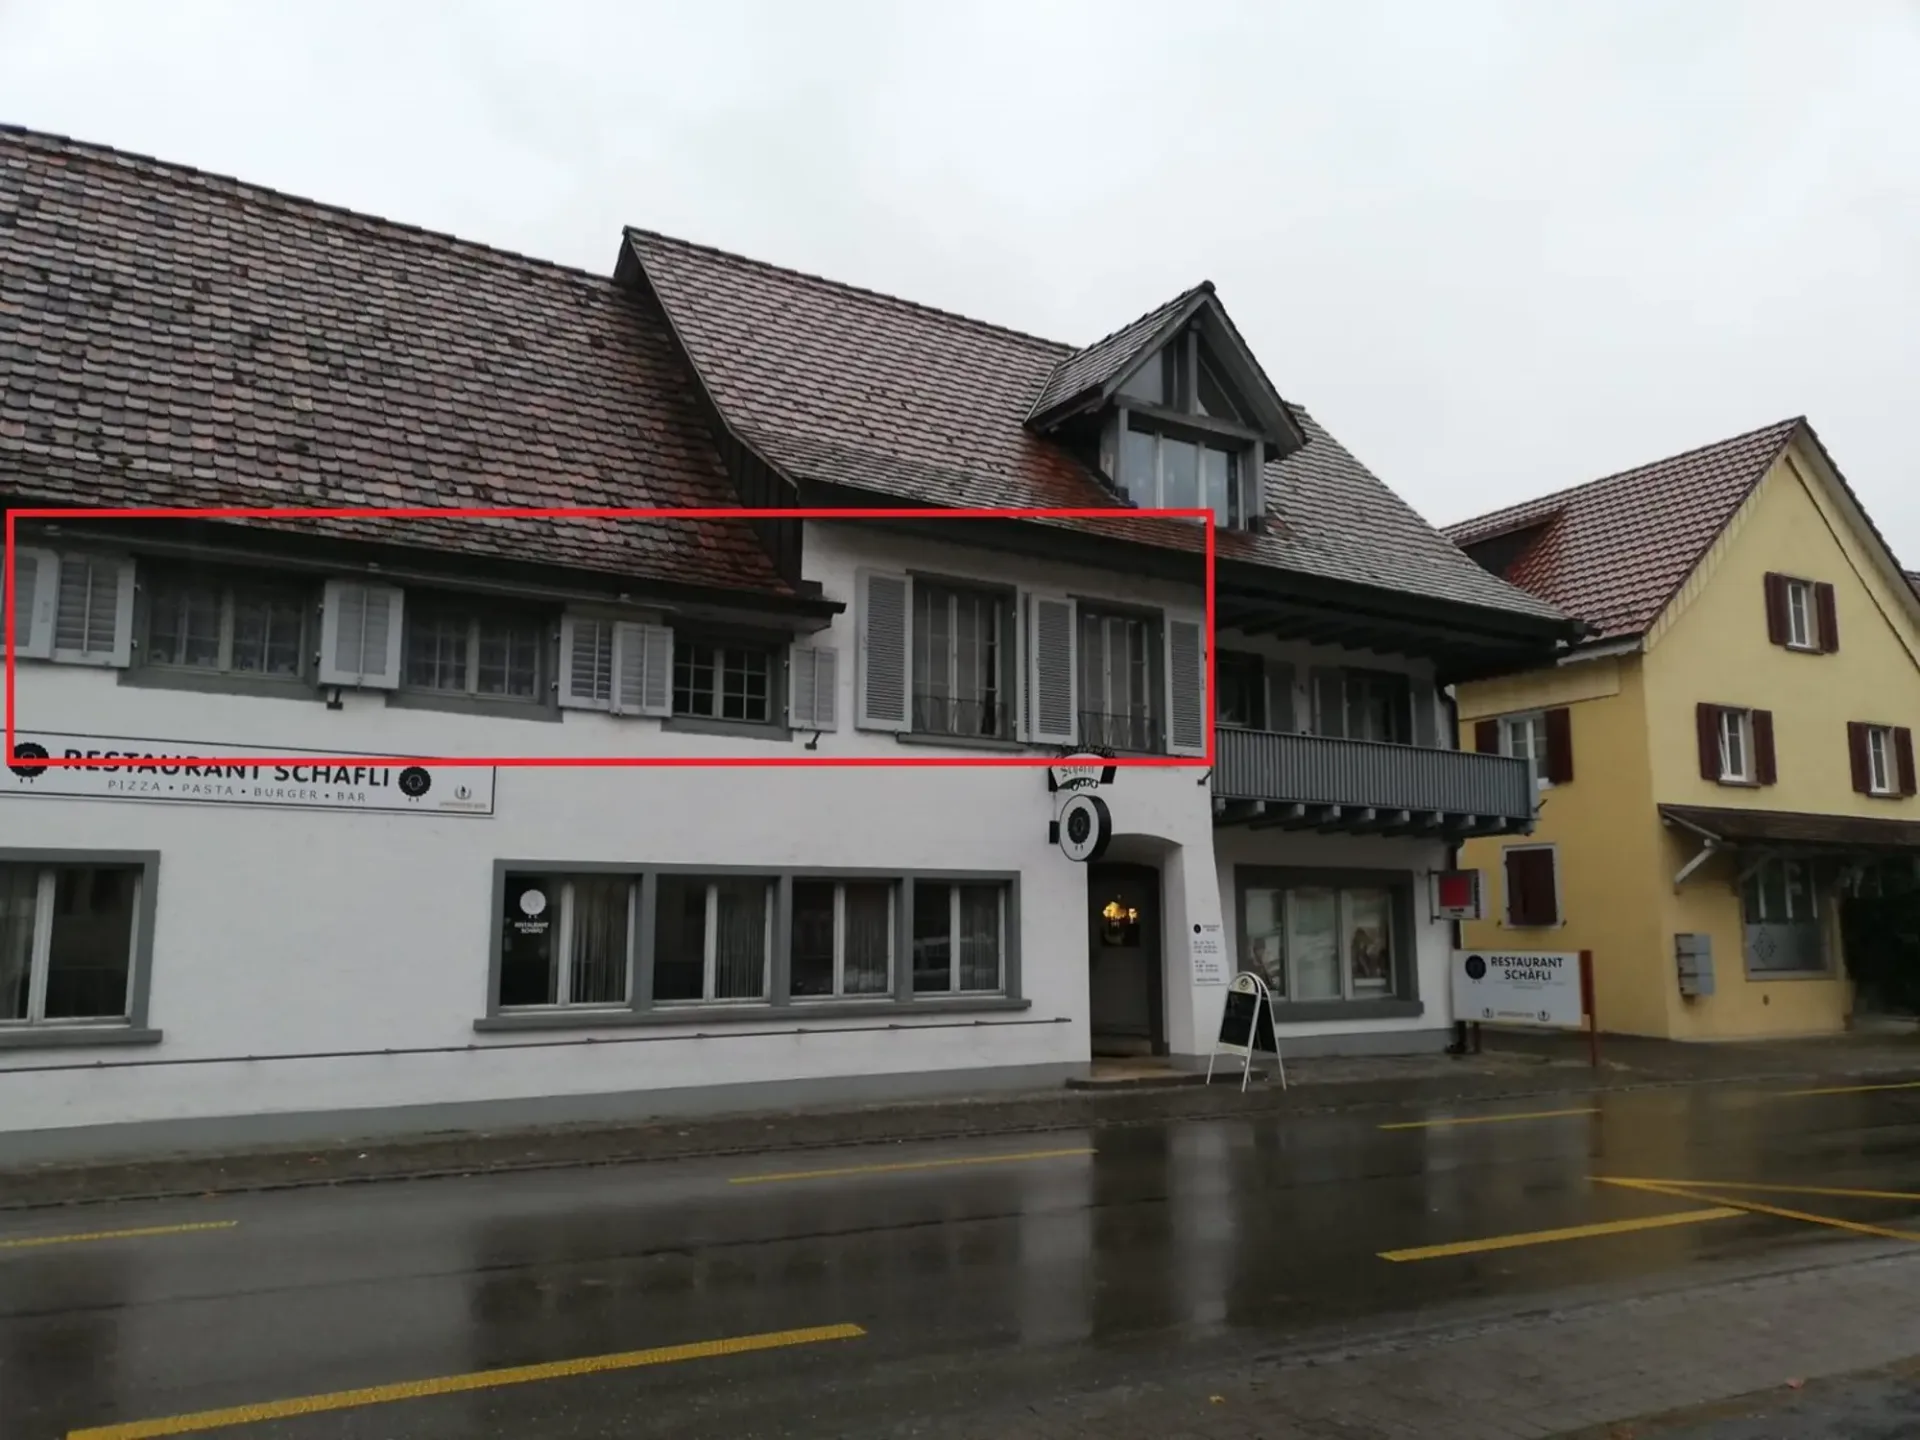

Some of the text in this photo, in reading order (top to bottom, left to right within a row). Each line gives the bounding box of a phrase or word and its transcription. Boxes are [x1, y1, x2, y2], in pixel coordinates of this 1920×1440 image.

[63, 749, 261, 780] RESTAURANT
[108, 779, 367, 802] PIZZA PASTA BURGER BAR
[1490, 956, 1563, 968] RESTAURANT
[1504, 968, 1552, 980] SCHÄFLI
